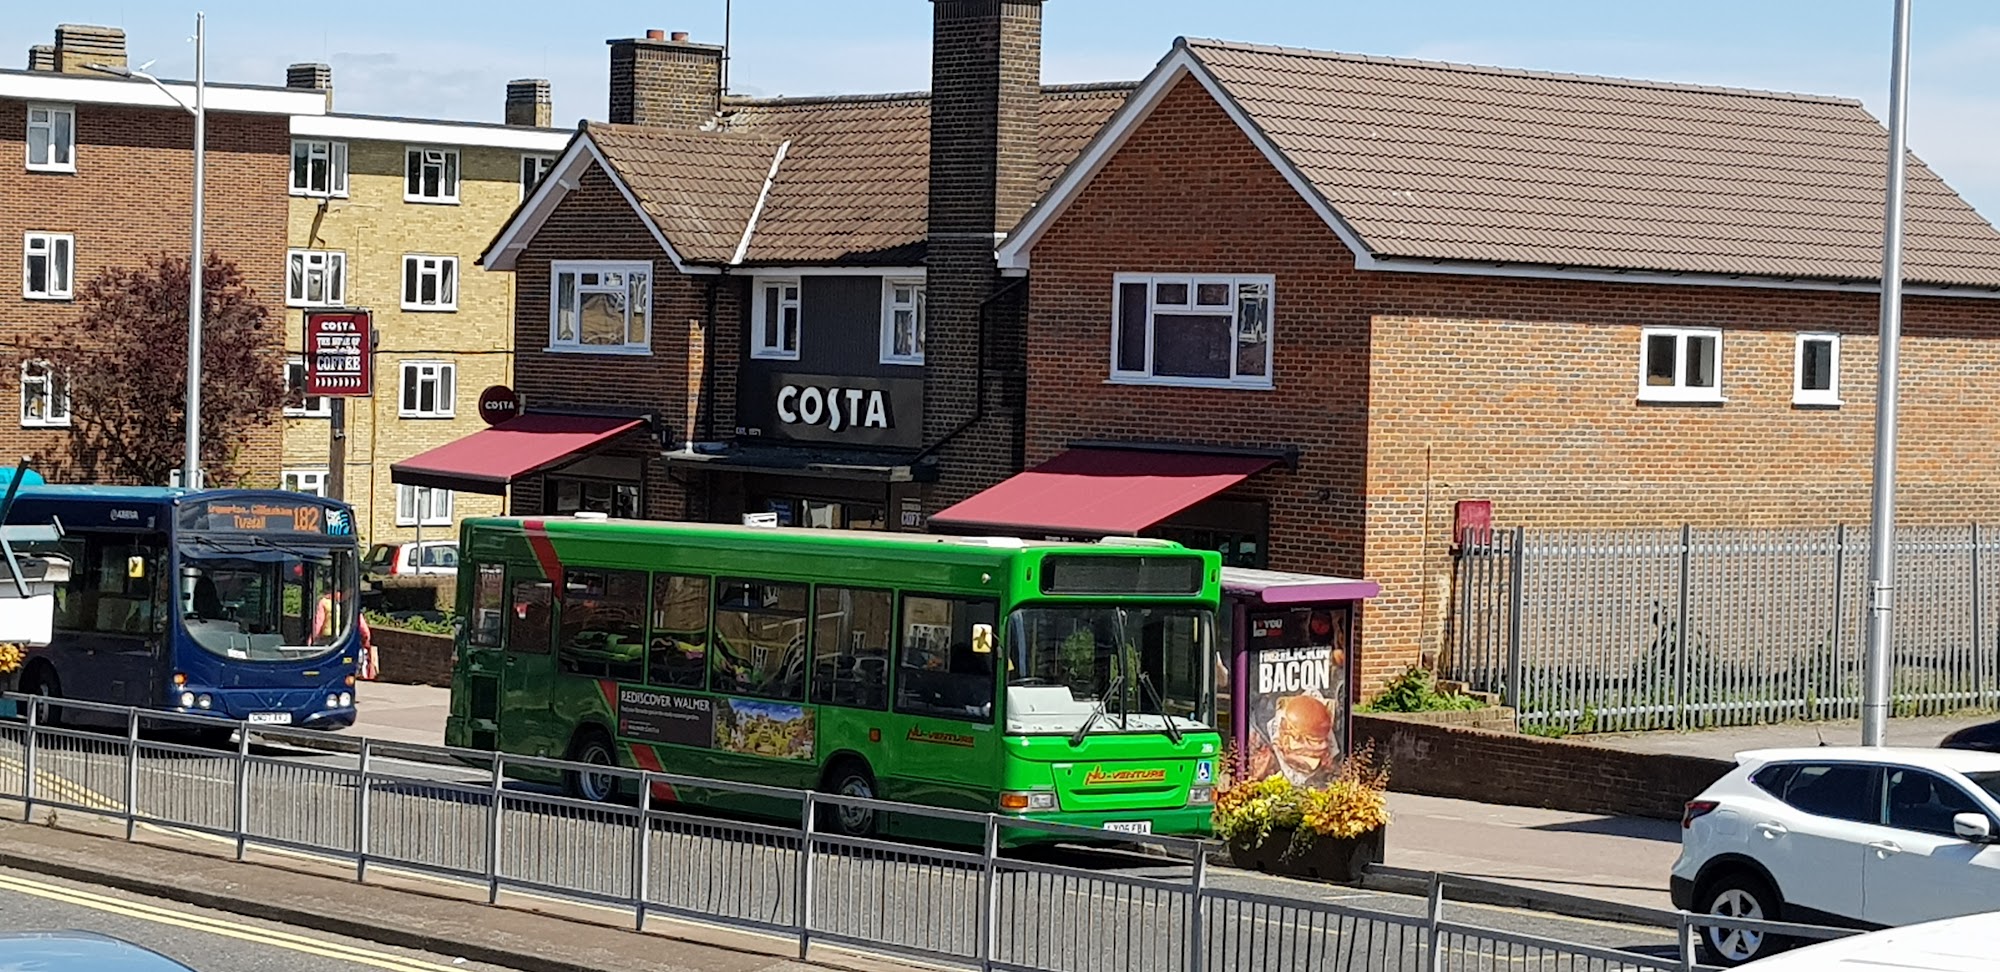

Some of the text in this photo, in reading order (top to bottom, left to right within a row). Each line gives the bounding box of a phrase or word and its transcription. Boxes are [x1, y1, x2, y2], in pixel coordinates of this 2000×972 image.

[321, 321, 356, 331] COSTA
[316, 356, 361, 371] COFFEE
[485, 401, 514, 410] COSTA
[777, 385, 887, 431] COSTA
[293, 506, 320, 531] 182
[1259, 661, 1330, 693] BACON
[621, 691, 710, 712] REDISCOVER WALMER
